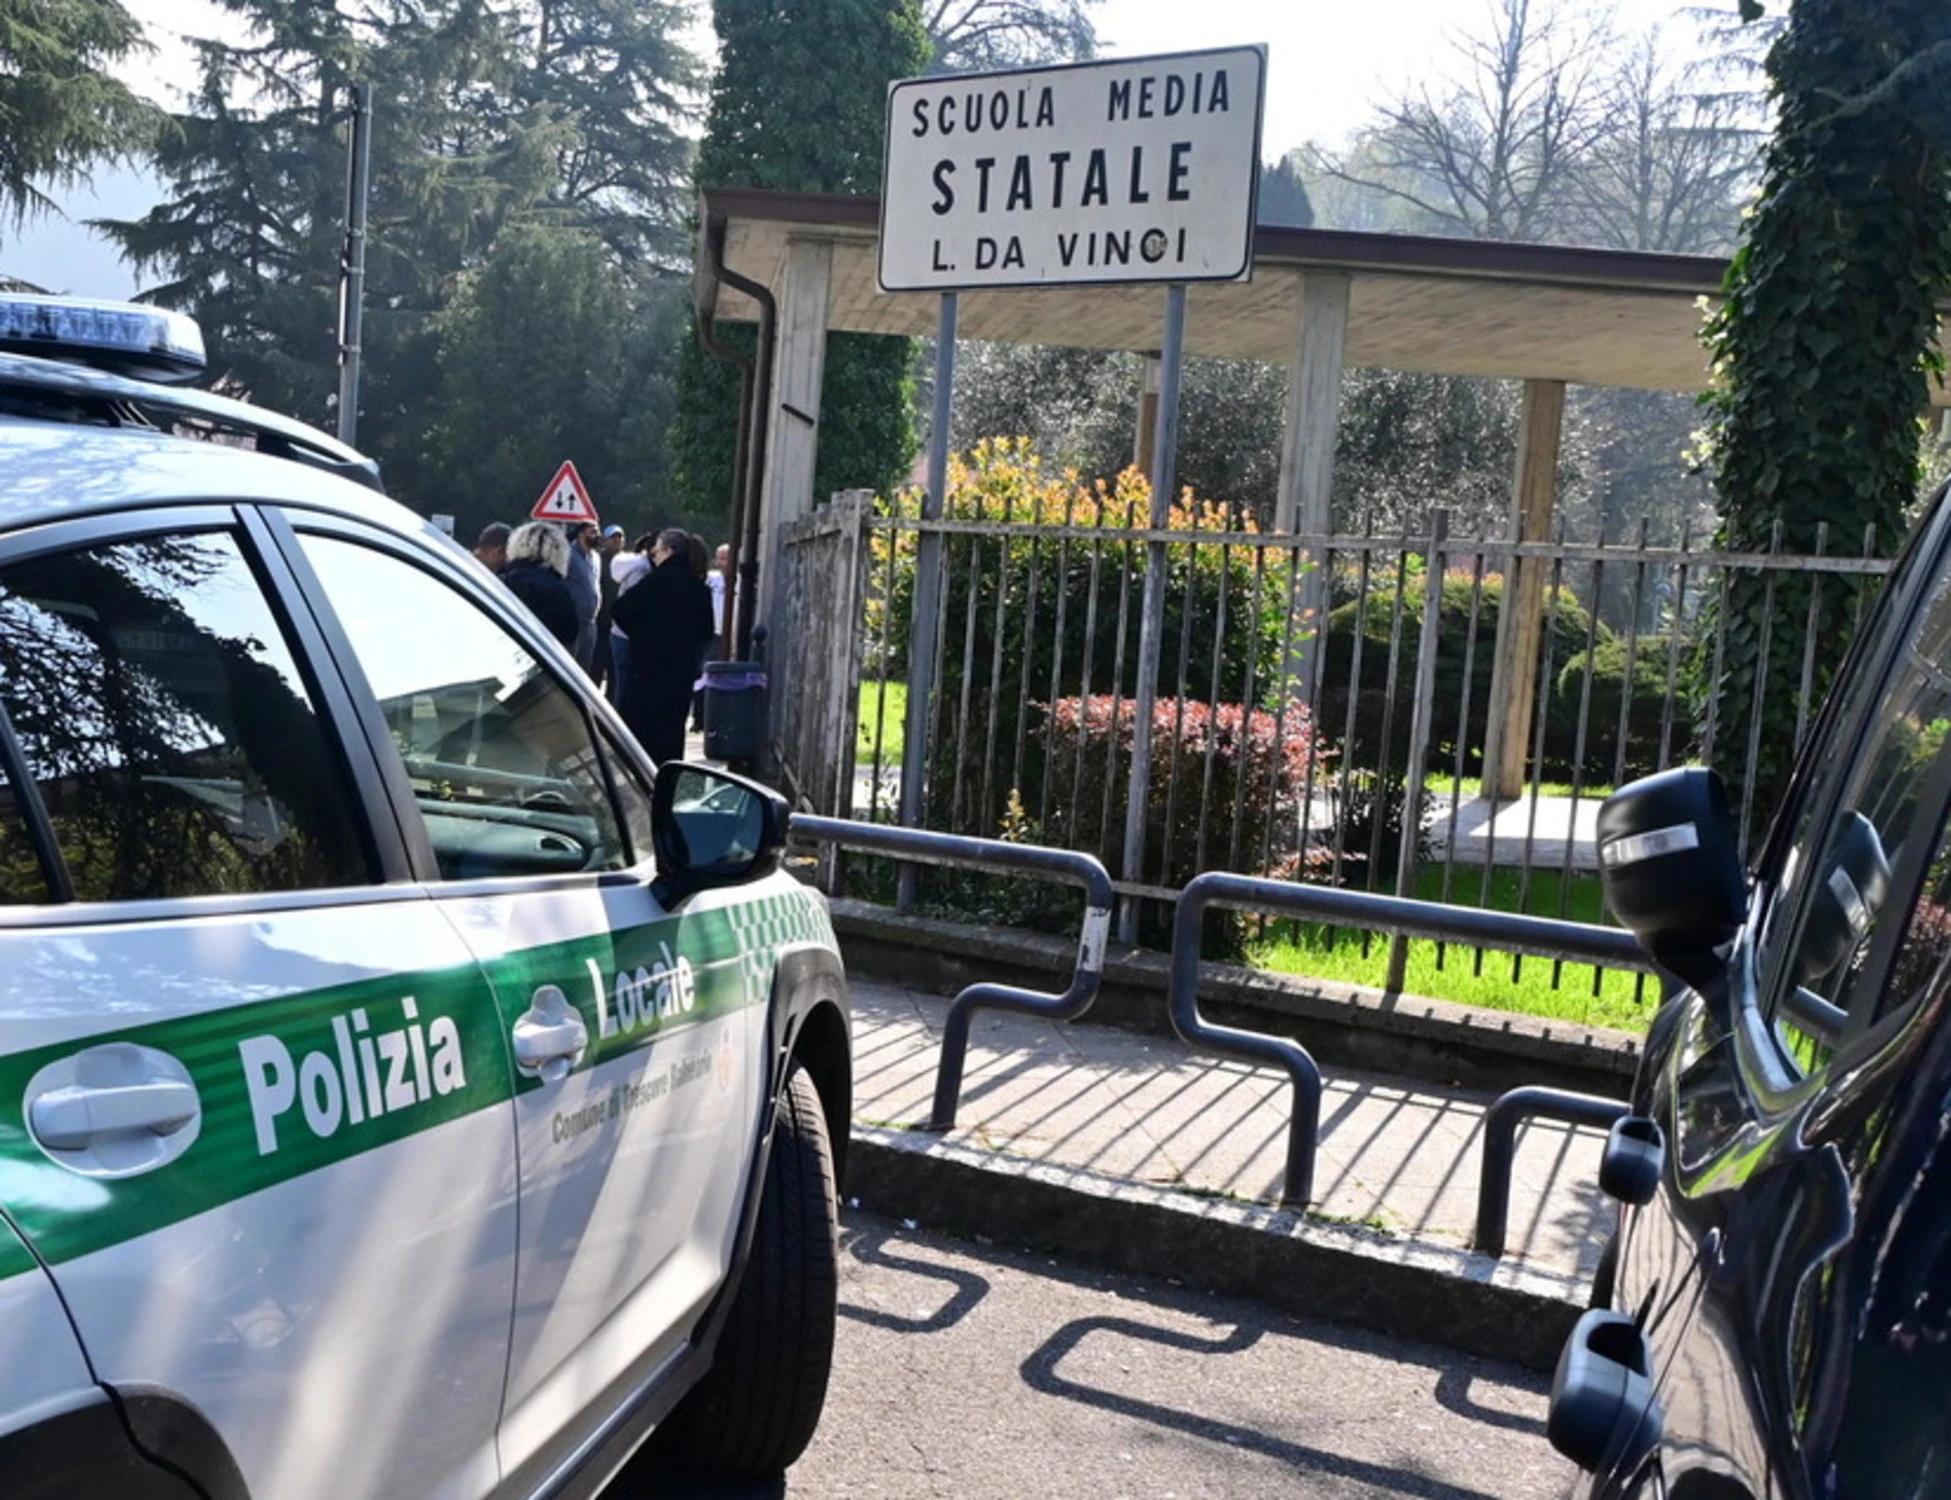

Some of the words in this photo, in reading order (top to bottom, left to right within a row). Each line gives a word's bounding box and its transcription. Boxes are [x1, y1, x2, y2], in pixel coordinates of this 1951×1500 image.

[912, 86, 1055, 137] SCUOLA
[1107, 69, 1230, 121] MEDIA
[931, 141, 1193, 215] STATALE
[932, 239, 956, 271] L.
[975, 236, 1025, 270] DA
[1057, 228, 1187, 267] VINCI
[237, 996, 467, 1156] Polizia
[585, 941, 696, 1040] Locale
[552, 1101, 606, 1145] Comune
